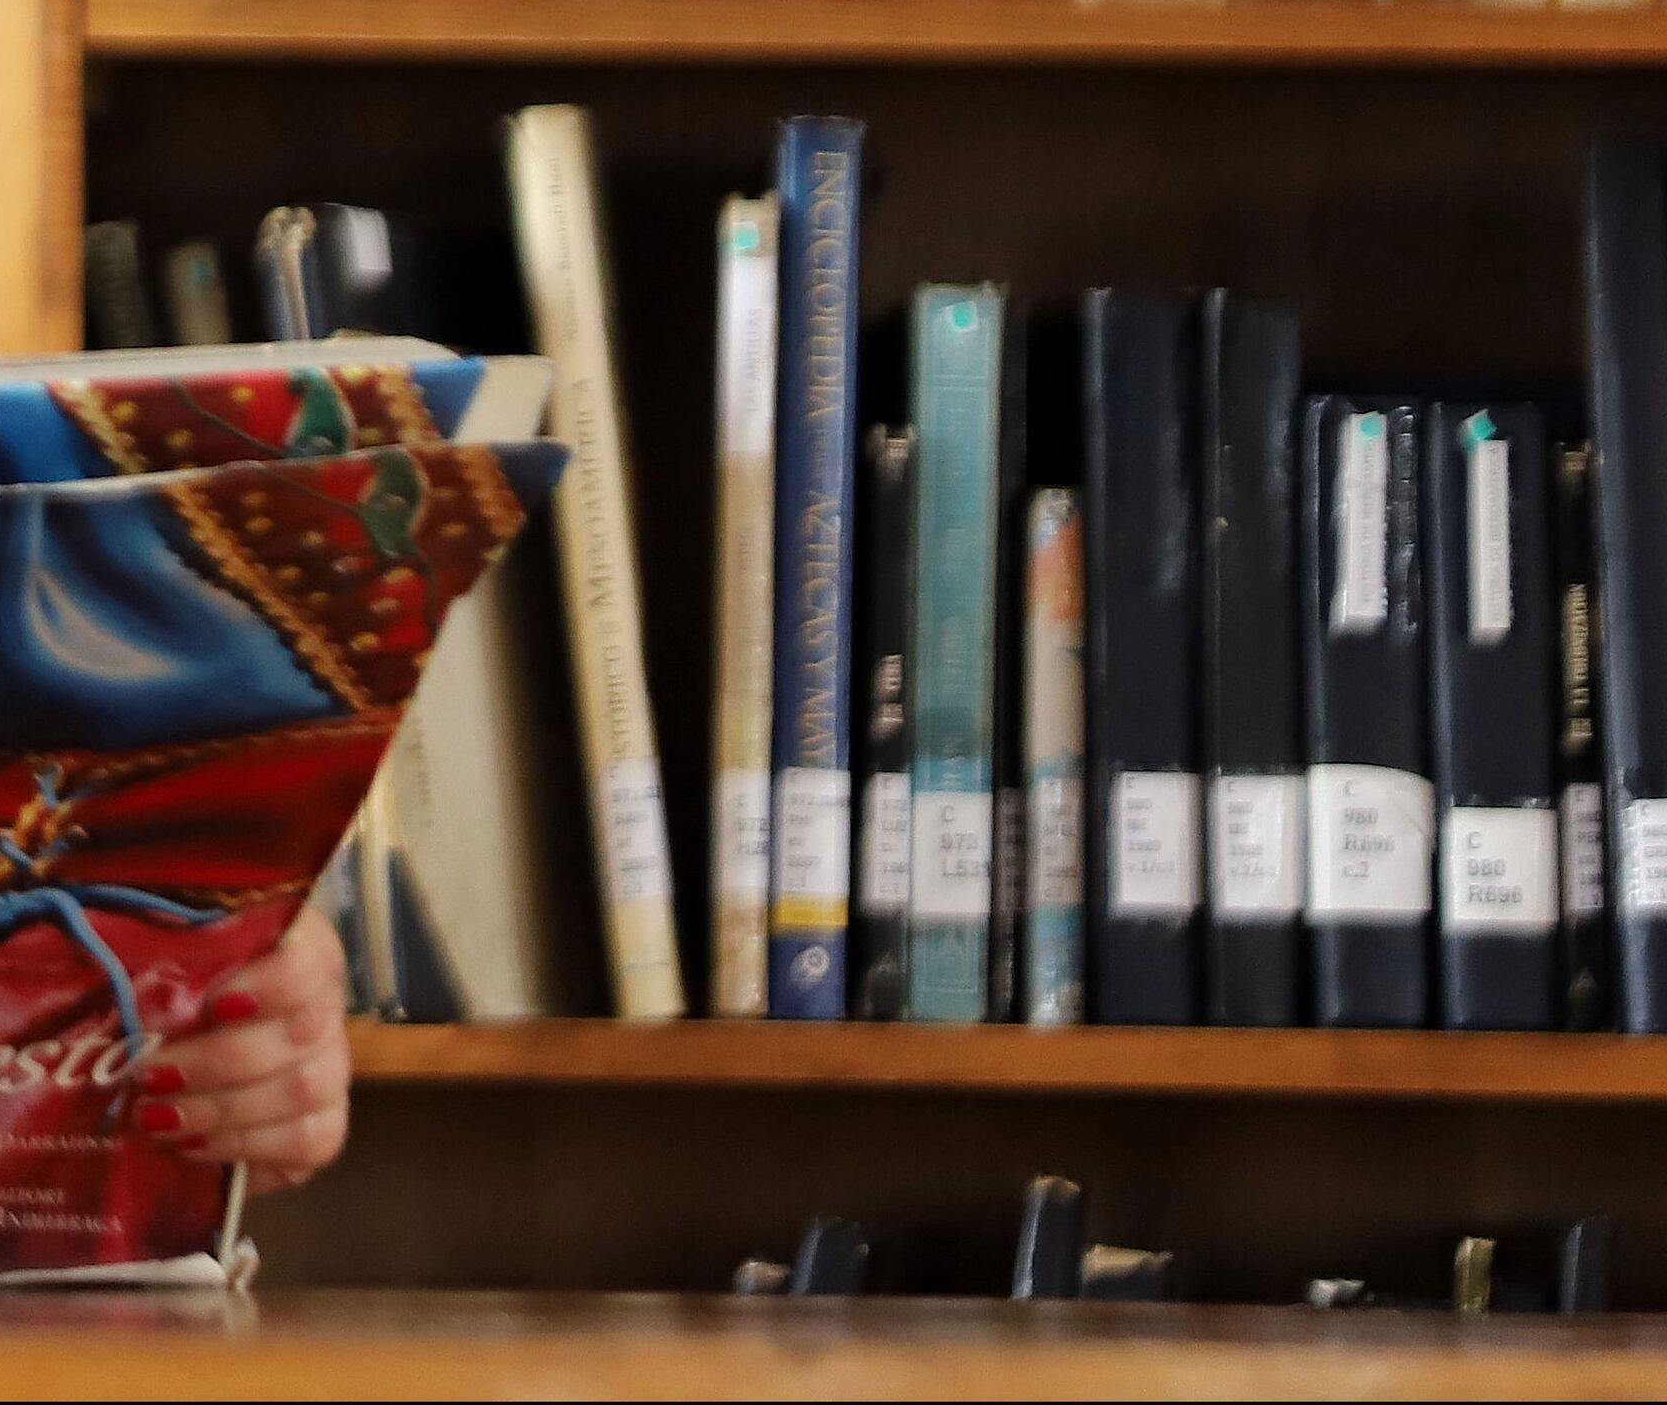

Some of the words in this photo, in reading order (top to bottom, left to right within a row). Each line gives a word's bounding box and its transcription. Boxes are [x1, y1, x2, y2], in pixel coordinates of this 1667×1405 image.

[941, 806, 955, 823] C
[1342, 807, 1378, 824] 980
[1468, 831, 1482, 849] C
[1468, 857, 1505, 876] 980
